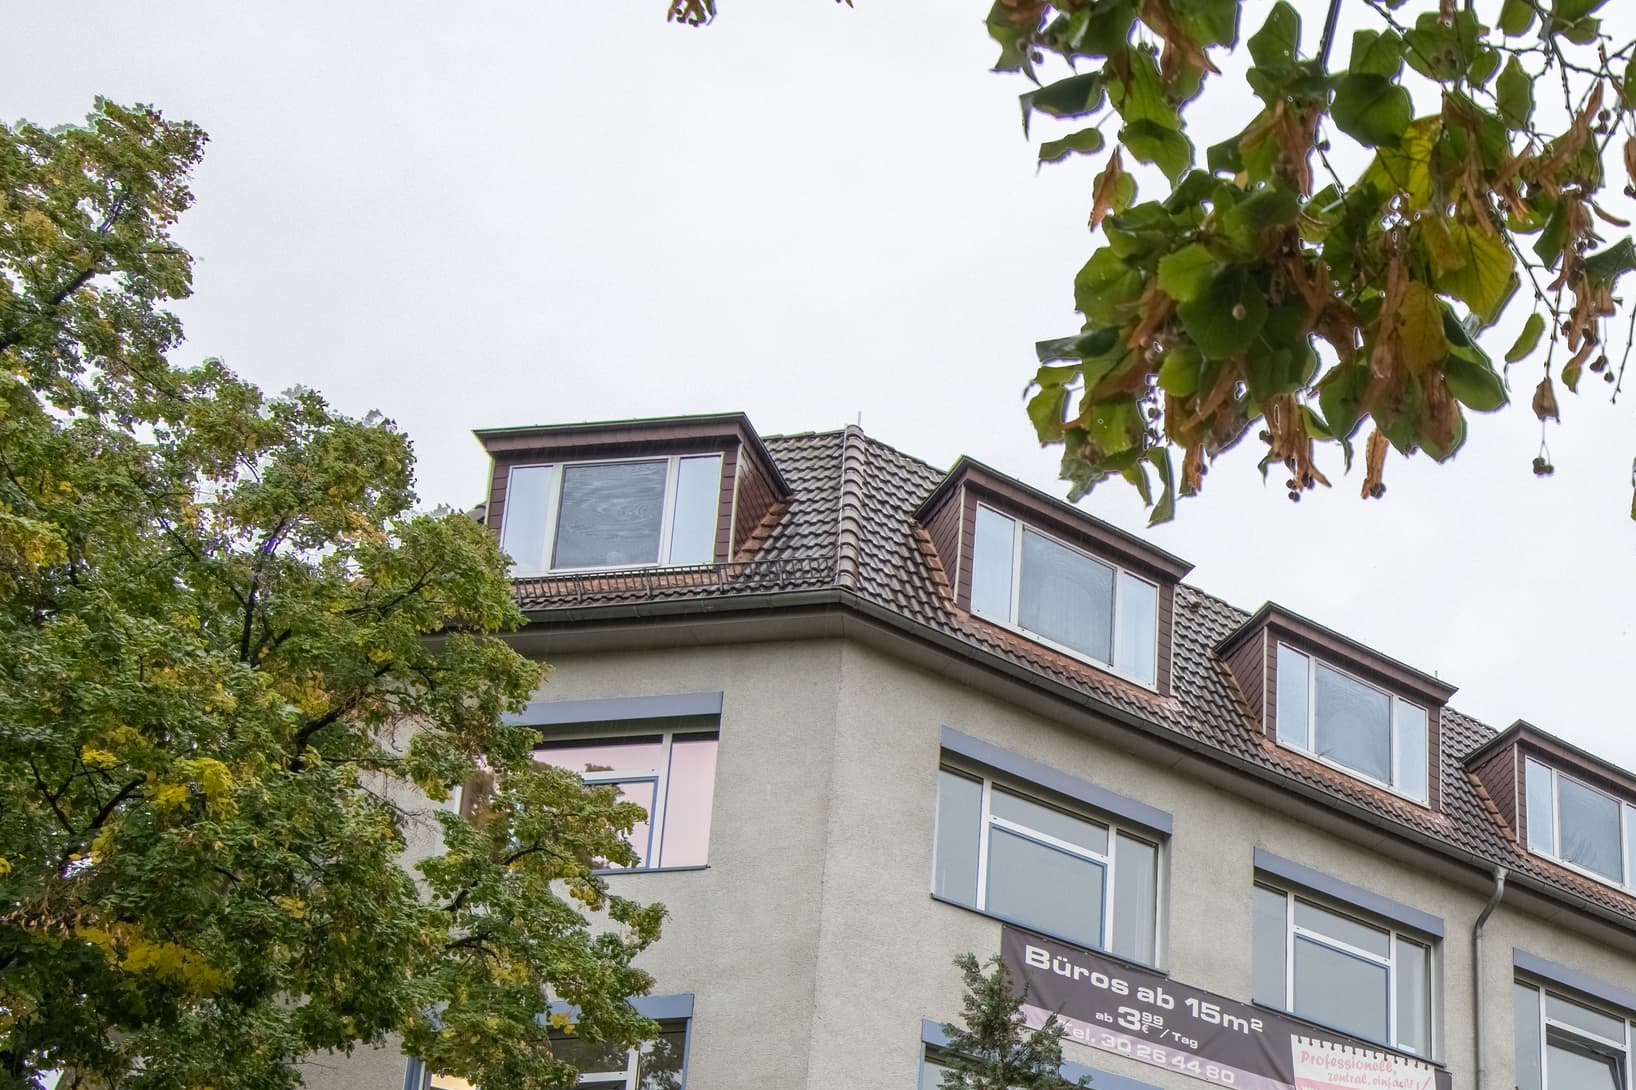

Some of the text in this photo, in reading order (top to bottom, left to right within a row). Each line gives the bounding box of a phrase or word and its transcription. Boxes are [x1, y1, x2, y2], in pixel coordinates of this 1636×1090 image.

[1025, 944, 1129, 996] Büros
[1137, 986, 1175, 1010] ab
[1095, 1011, 1113, 1023] ab
[1171, 1031, 1199, 1049] Tag
[1101, 1034, 1132, 1053] 30
[1136, 1044, 1167, 1064] 26
[1171, 1055, 1201, 1075] 44
[1206, 1065, 1235, 1084] 80
